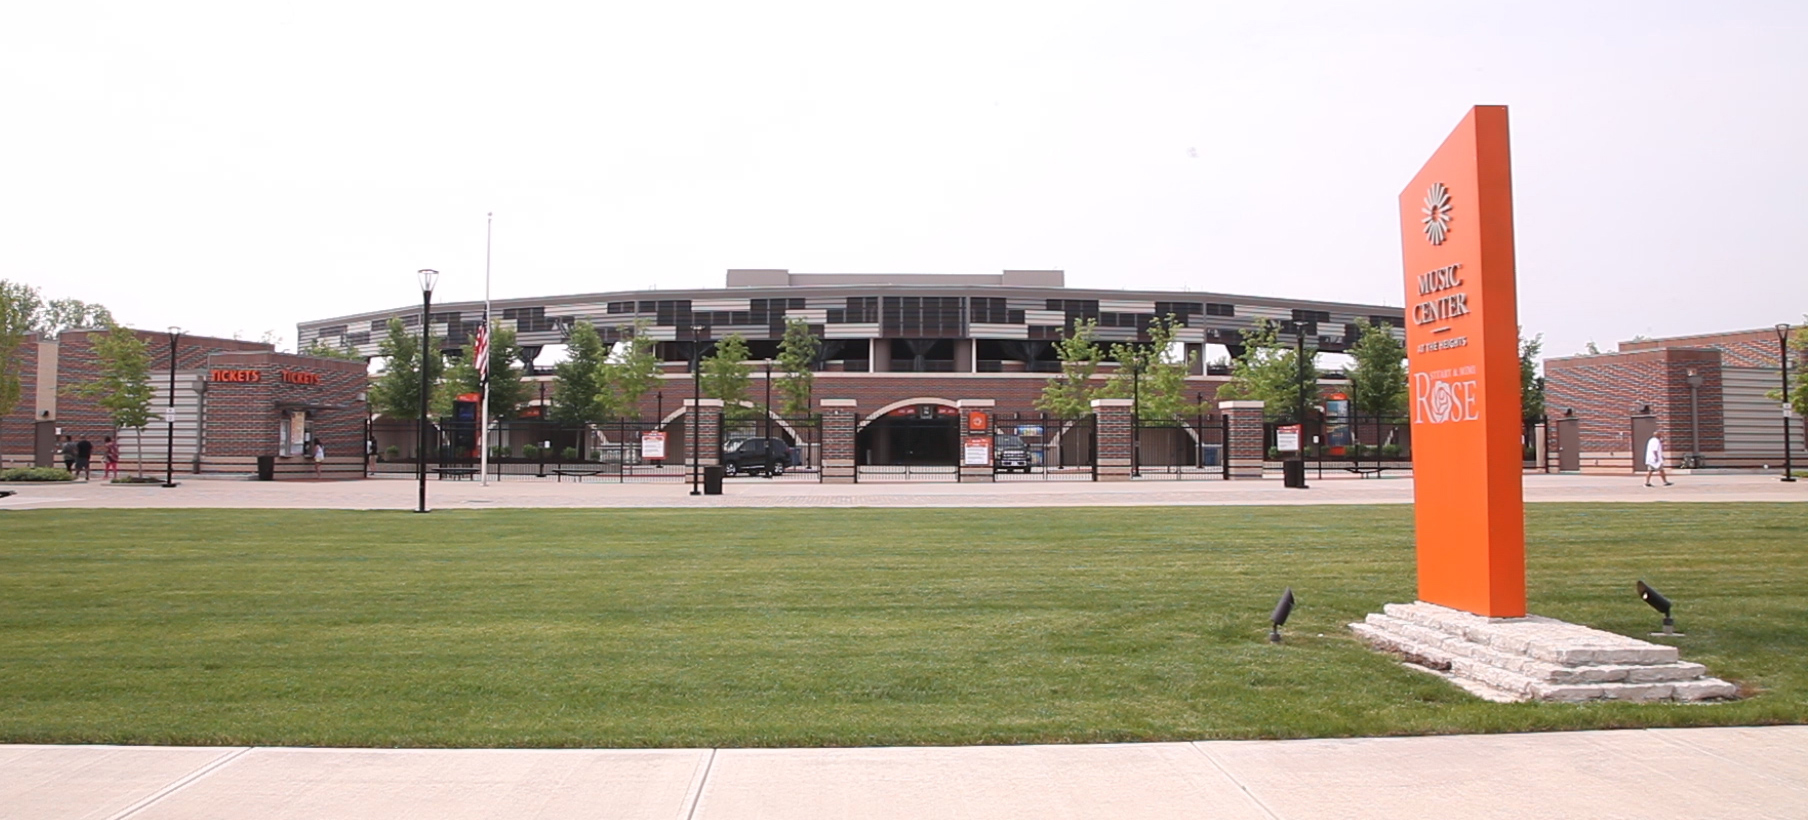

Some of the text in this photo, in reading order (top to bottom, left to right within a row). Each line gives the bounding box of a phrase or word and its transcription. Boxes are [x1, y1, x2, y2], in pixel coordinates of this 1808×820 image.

[1418, 263, 1463, 296] MUSIC
[1412, 293, 1470, 326] CENTER
[1417, 336, 1468, 354] AT THE HEIGHTS
[211, 369, 261, 382] TICKETS
[281, 370, 320, 384] TICKETS
